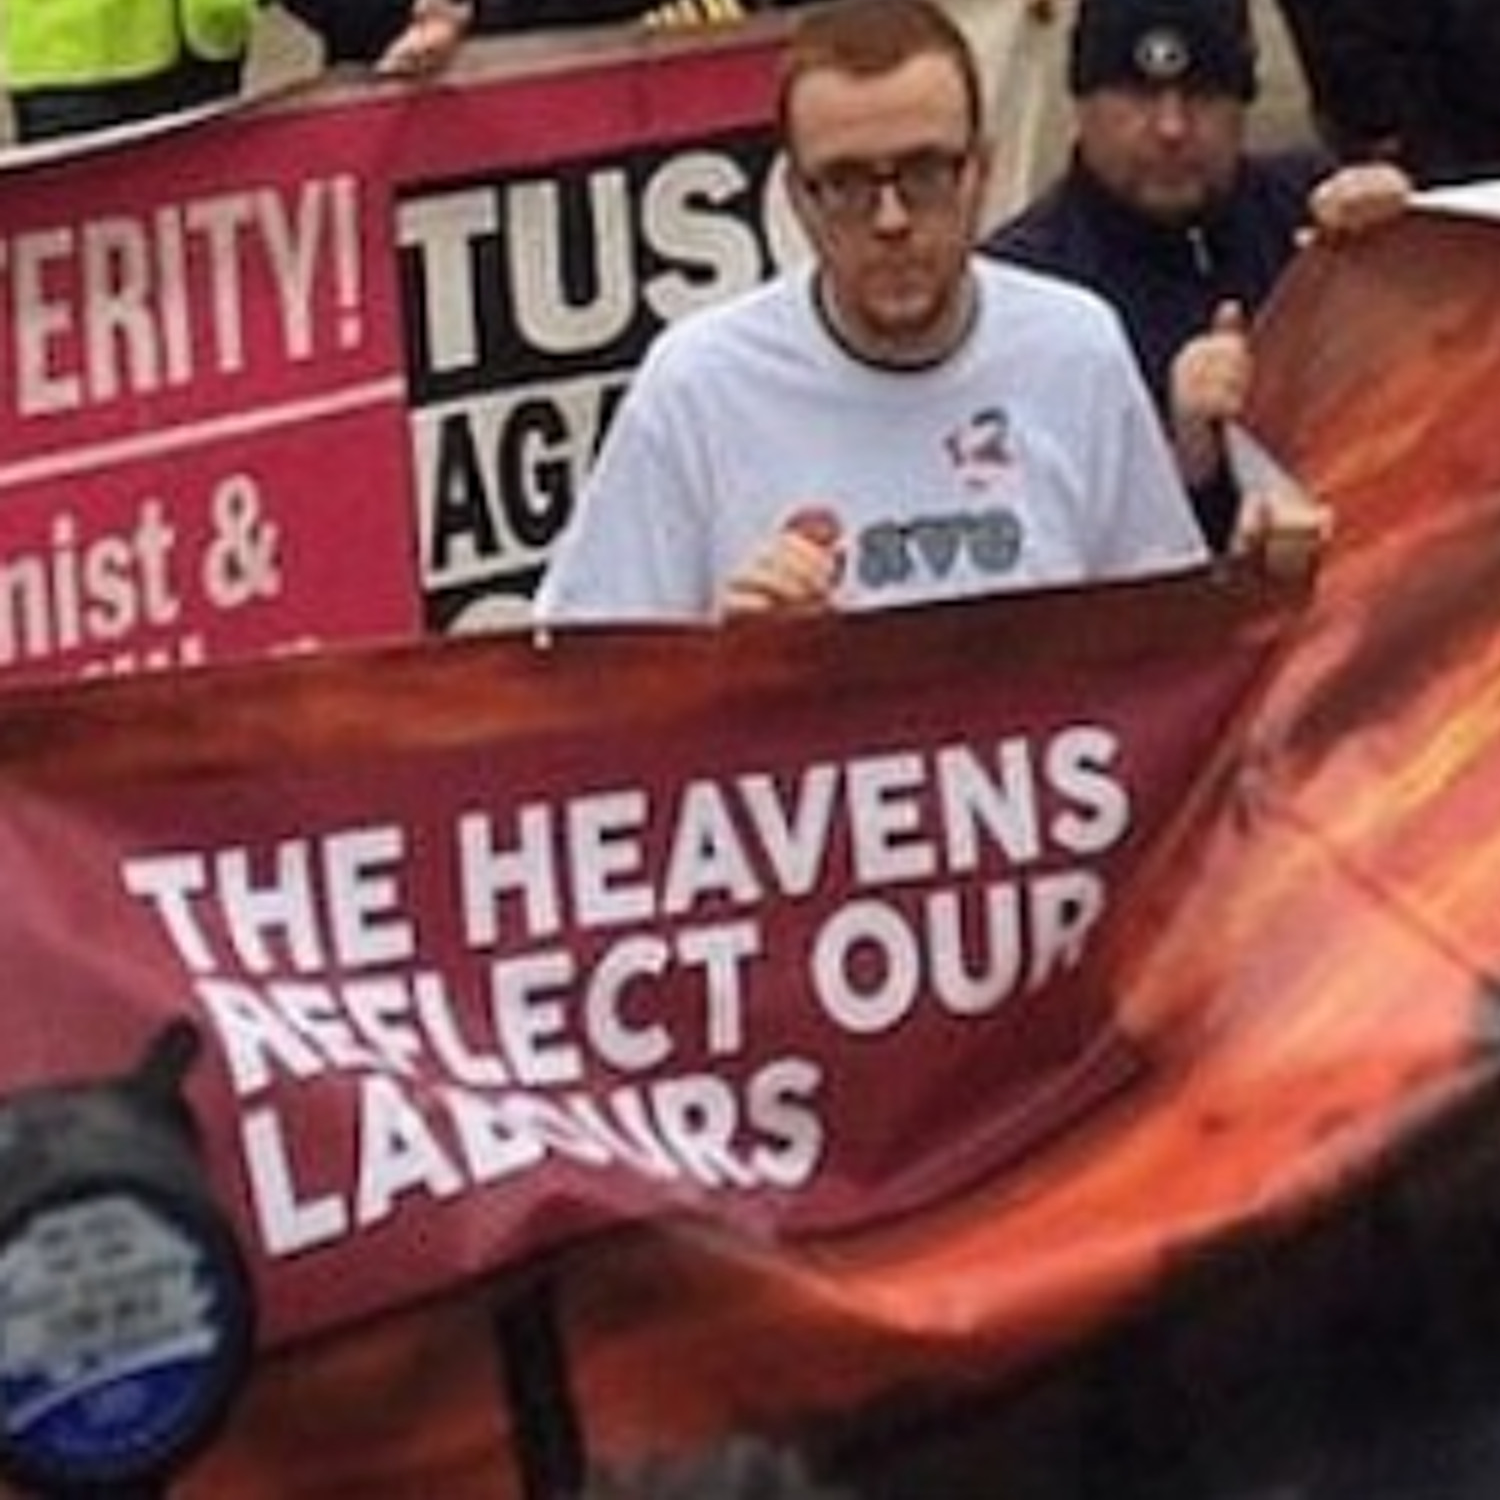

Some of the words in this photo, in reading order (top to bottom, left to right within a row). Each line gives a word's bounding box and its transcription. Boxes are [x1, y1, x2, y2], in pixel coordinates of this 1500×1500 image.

[0, 173, 363, 417] ERITY!
[204, 473, 284, 608] &
[122, 825, 414, 975] THE
[458, 725, 1132, 946] HEAVENS
[196, 920, 760, 1094] REFLECT
[810, 869, 1108, 1034] OUR
